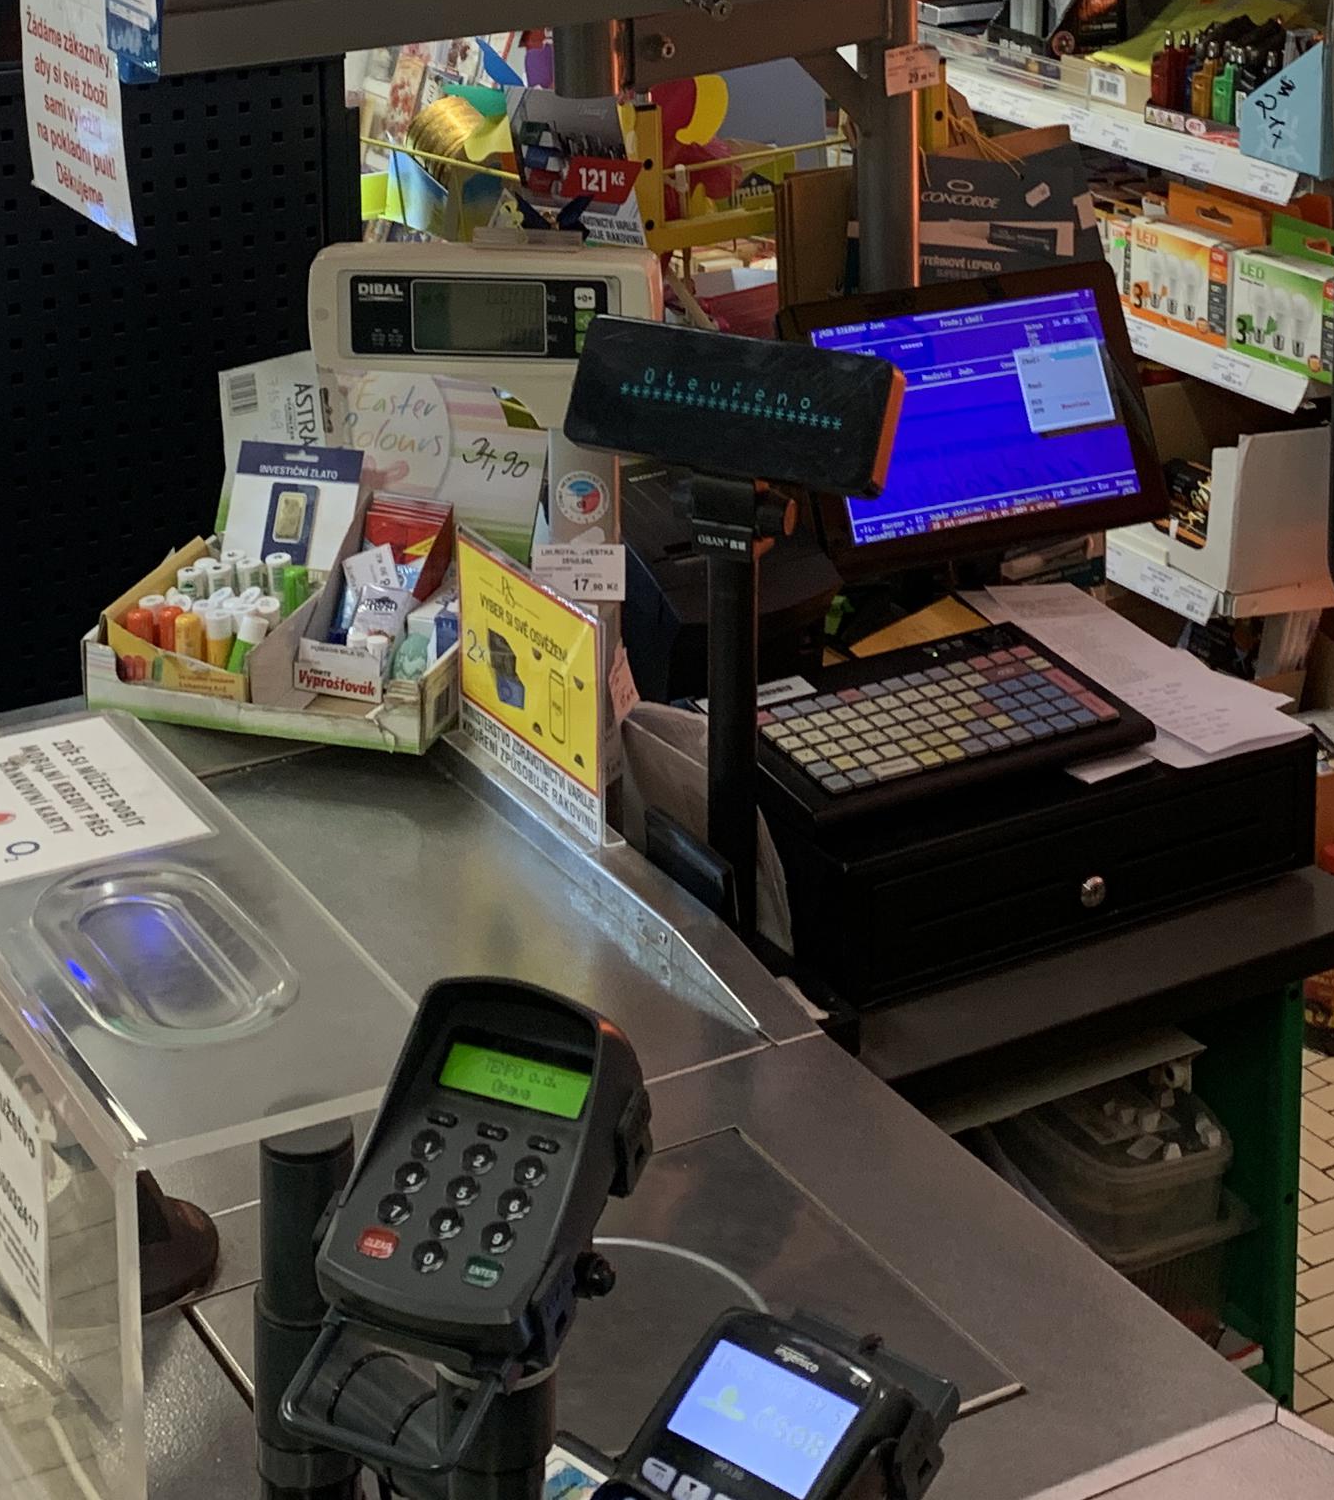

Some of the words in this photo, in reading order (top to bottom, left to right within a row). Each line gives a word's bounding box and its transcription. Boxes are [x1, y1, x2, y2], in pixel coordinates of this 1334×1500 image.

[27, 6, 62, 48] Žádáme
[64, 33, 112, 78] zákazníky,
[35, 55, 51, 84] aby
[54, 63, 62, 85] si
[64, 72, 80, 94] své
[83, 79, 108, 108] zboží
[44, 93, 67, 119] sami
[36, 121, 49, 141] na
[51, 128, 91, 167] pokladní
[93, 152, 116, 180] pult!
[56, 161, 104, 207] Děkujeme
[578, 167, 607, 193] 121
[611, 171, 625, 186] Kč
[921, 191, 1000, 209] CONCORDE
[1136, 229, 1158, 247] LED
[1239, 260, 1265, 280] LED
[358, 282, 404, 297] DIBAL
[1133, 282, 1143, 308] 3
[1235, 316, 1247, 345] 3
[356, 375, 437, 418] Easter
[293, 382, 321, 448] ASTRA
[259, 463, 309, 479] INVESTIČNÍ
[310, 467, 338, 481] ZLATO
[572, 579, 588, 592] 17
[479, 592, 505, 623] VYBER
[506, 614, 514, 628] SI
[514, 615, 529, 640] SVÉ
[298, 670, 376, 697] Vyprošťovák
[512, 734, 566, 791] ZDRAVOTNICTVÍ
[53, 776, 94, 815] KREDIT
[499, 746, 550, 799] ZPŮSOBUJE
[550, 788, 597, 836] RAKOVINU
[36, 800, 75, 835] KARTY
[468, 1265, 498, 1279] ENTER
